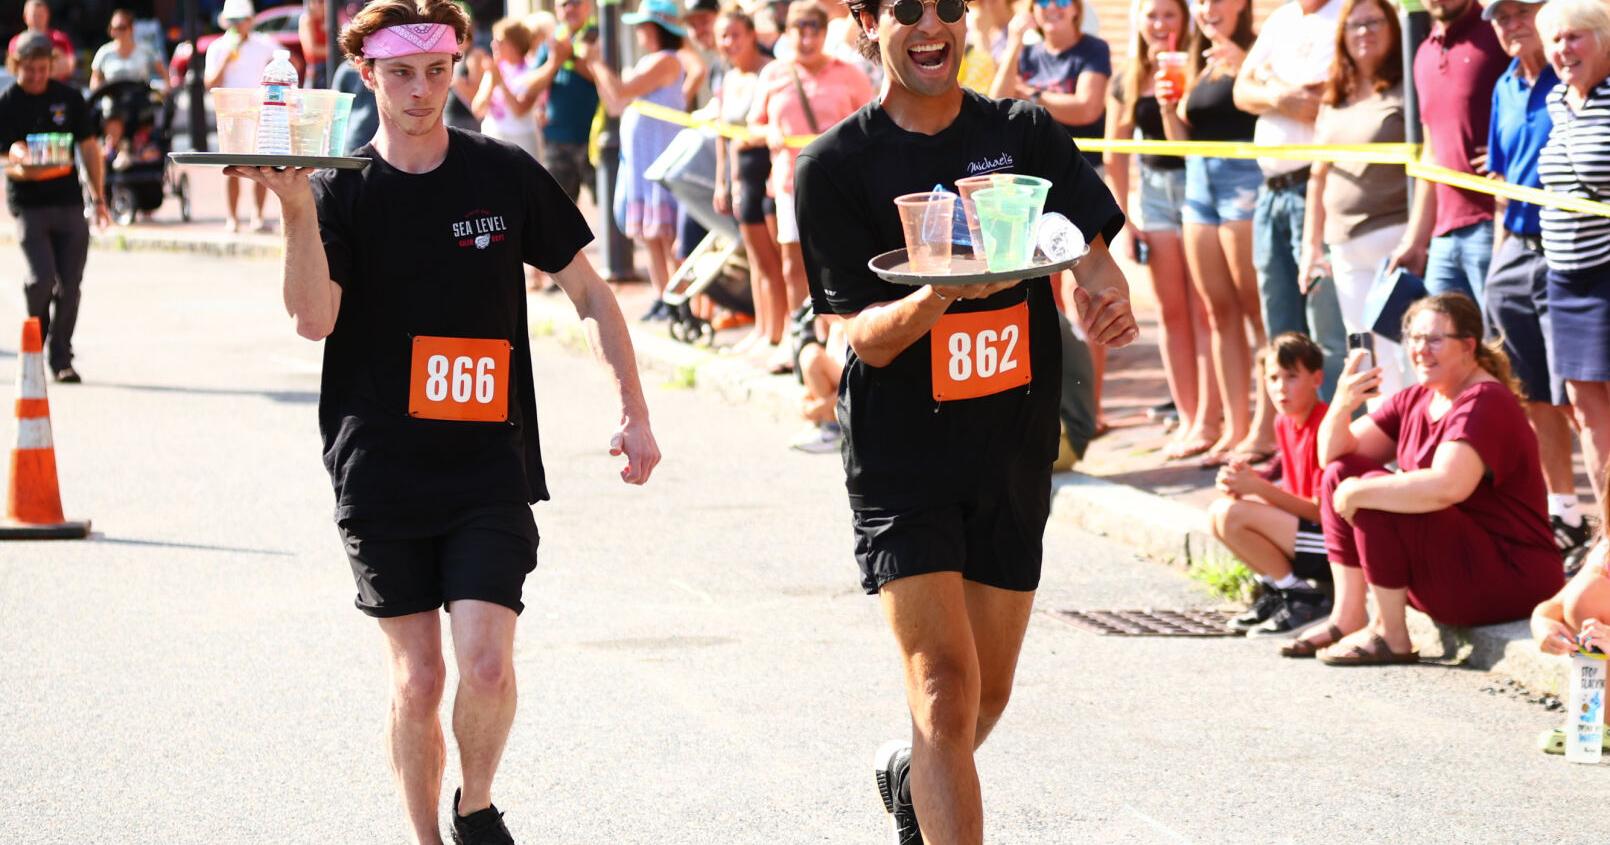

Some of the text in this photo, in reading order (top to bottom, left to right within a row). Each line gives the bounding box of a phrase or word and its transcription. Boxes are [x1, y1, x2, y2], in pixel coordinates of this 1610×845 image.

[967, 151, 1013, 173] Michael's
[452, 216, 507, 237] SEA LEVEL
[948, 324, 1019, 382] 862
[426, 354, 496, 404] 866
